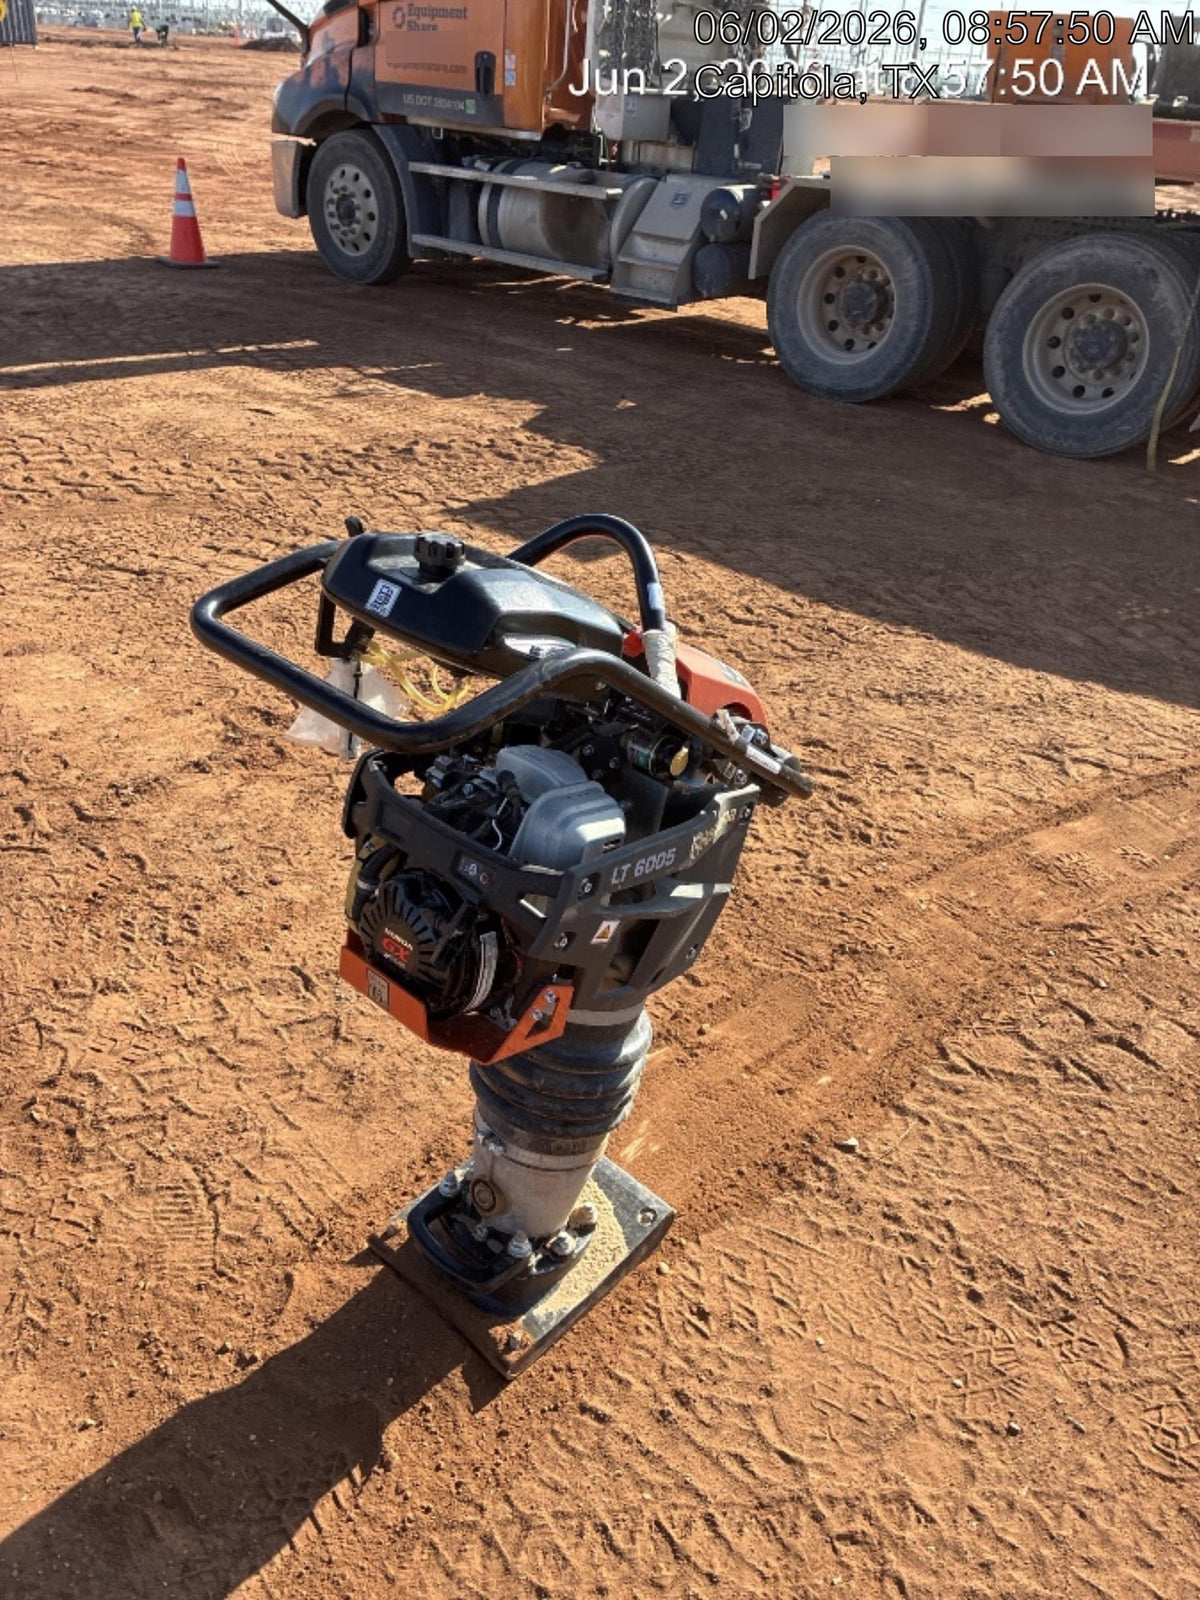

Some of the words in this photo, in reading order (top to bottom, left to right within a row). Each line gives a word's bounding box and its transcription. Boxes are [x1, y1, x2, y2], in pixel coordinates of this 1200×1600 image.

[407, 3, 468, 20] Equipment
[407, 20, 439, 31] Share
[403, 94, 415, 105] US
[415, 95, 433, 107] DOT
[611, 863, 632, 885] LT
[634, 848, 677, 877] 6005
[382, 937, 412, 963] GX
